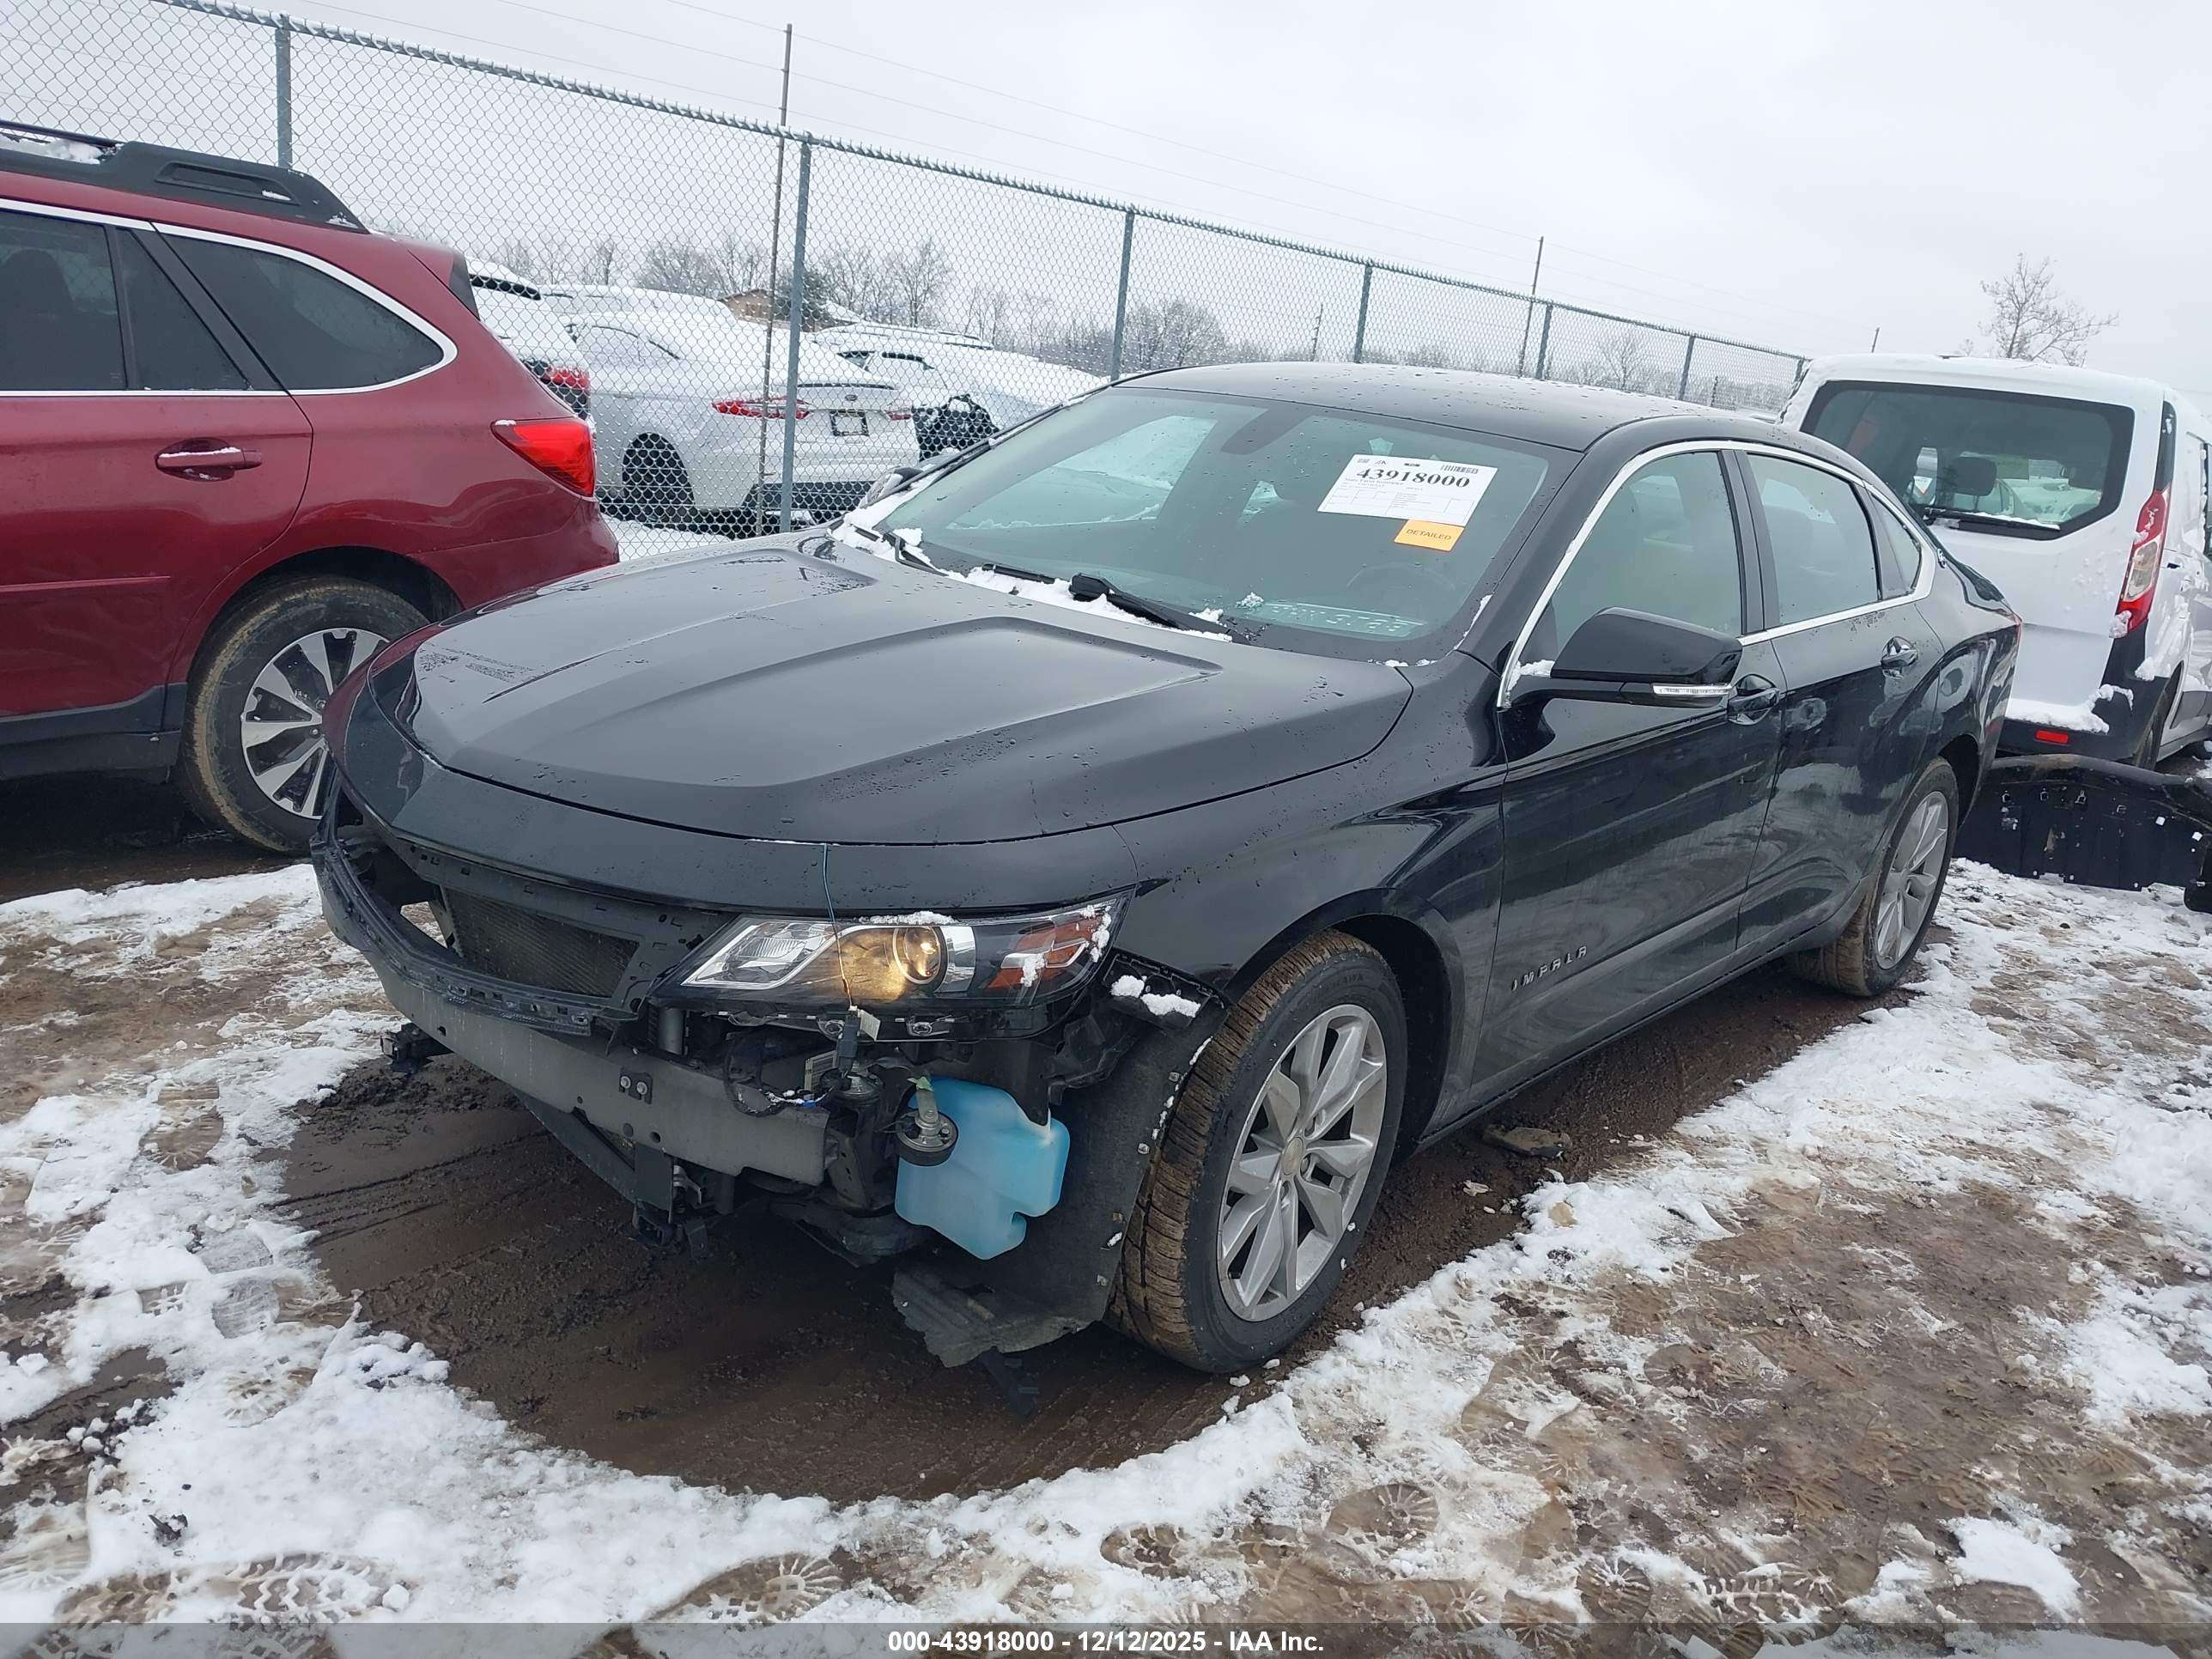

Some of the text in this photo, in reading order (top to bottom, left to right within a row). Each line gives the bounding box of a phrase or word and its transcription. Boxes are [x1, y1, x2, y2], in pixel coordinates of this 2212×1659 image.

[1356, 467, 1470, 488] 43918000
[1406, 528, 1452, 540] DETAILED
[1511, 945, 1587, 991] IMPALA
